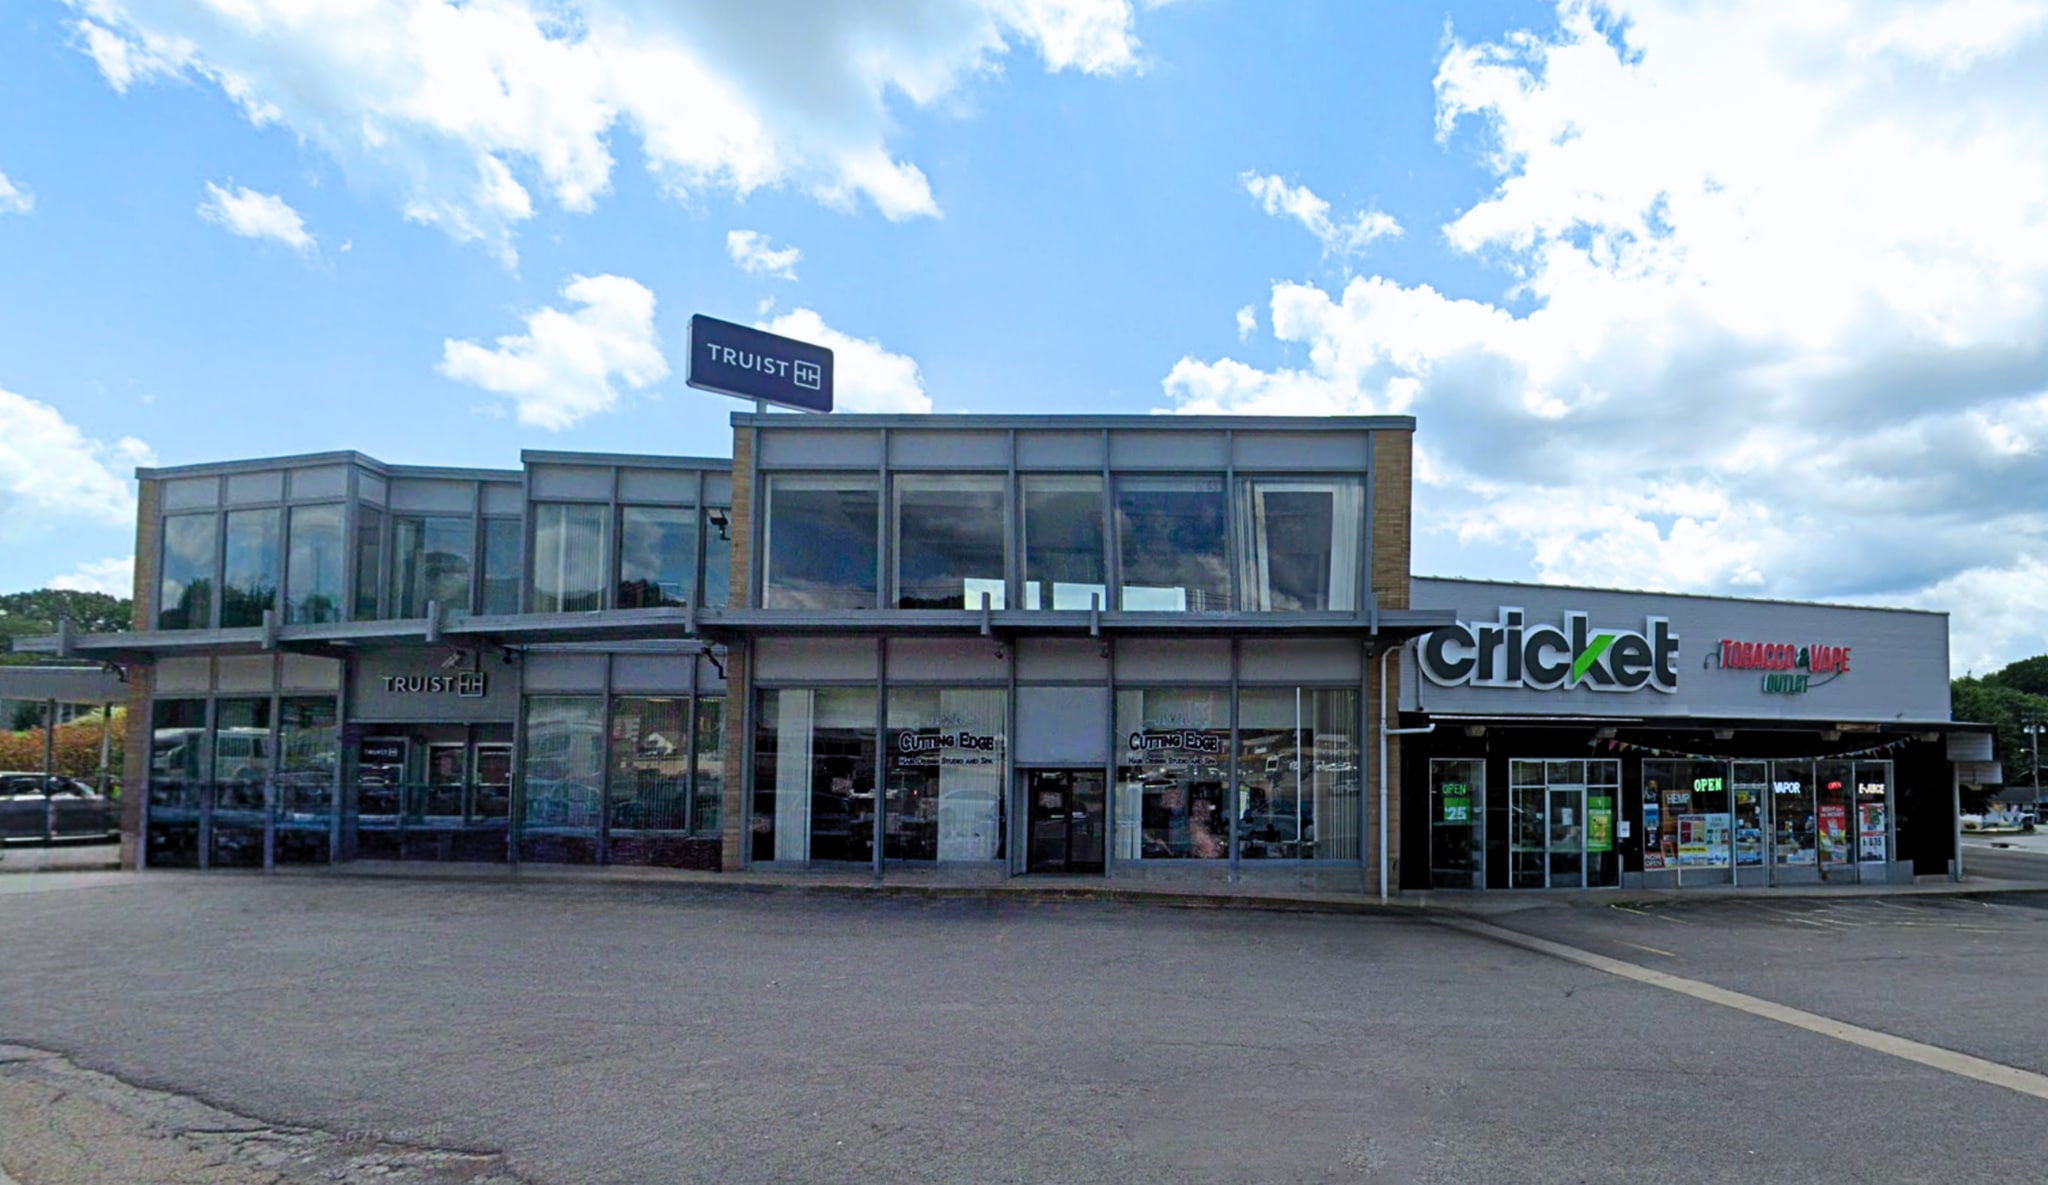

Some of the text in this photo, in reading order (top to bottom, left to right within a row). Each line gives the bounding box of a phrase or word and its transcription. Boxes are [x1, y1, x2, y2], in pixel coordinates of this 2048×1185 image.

[706, 342, 790, 377] TRUIST
[1420, 607, 1679, 692] cricket
[1719, 639, 1851, 672] TOBACCO & VAPE
[383, 676, 453, 692] TRUIST
[1763, 674, 1810, 693] OUTLET
[1128, 731, 1219, 752] CUTTING EDGE
[1442, 783, 1467, 795] OPEN
[1693, 777, 1722, 792] OPEN
[1773, 781, 1800, 794] VAPOR
